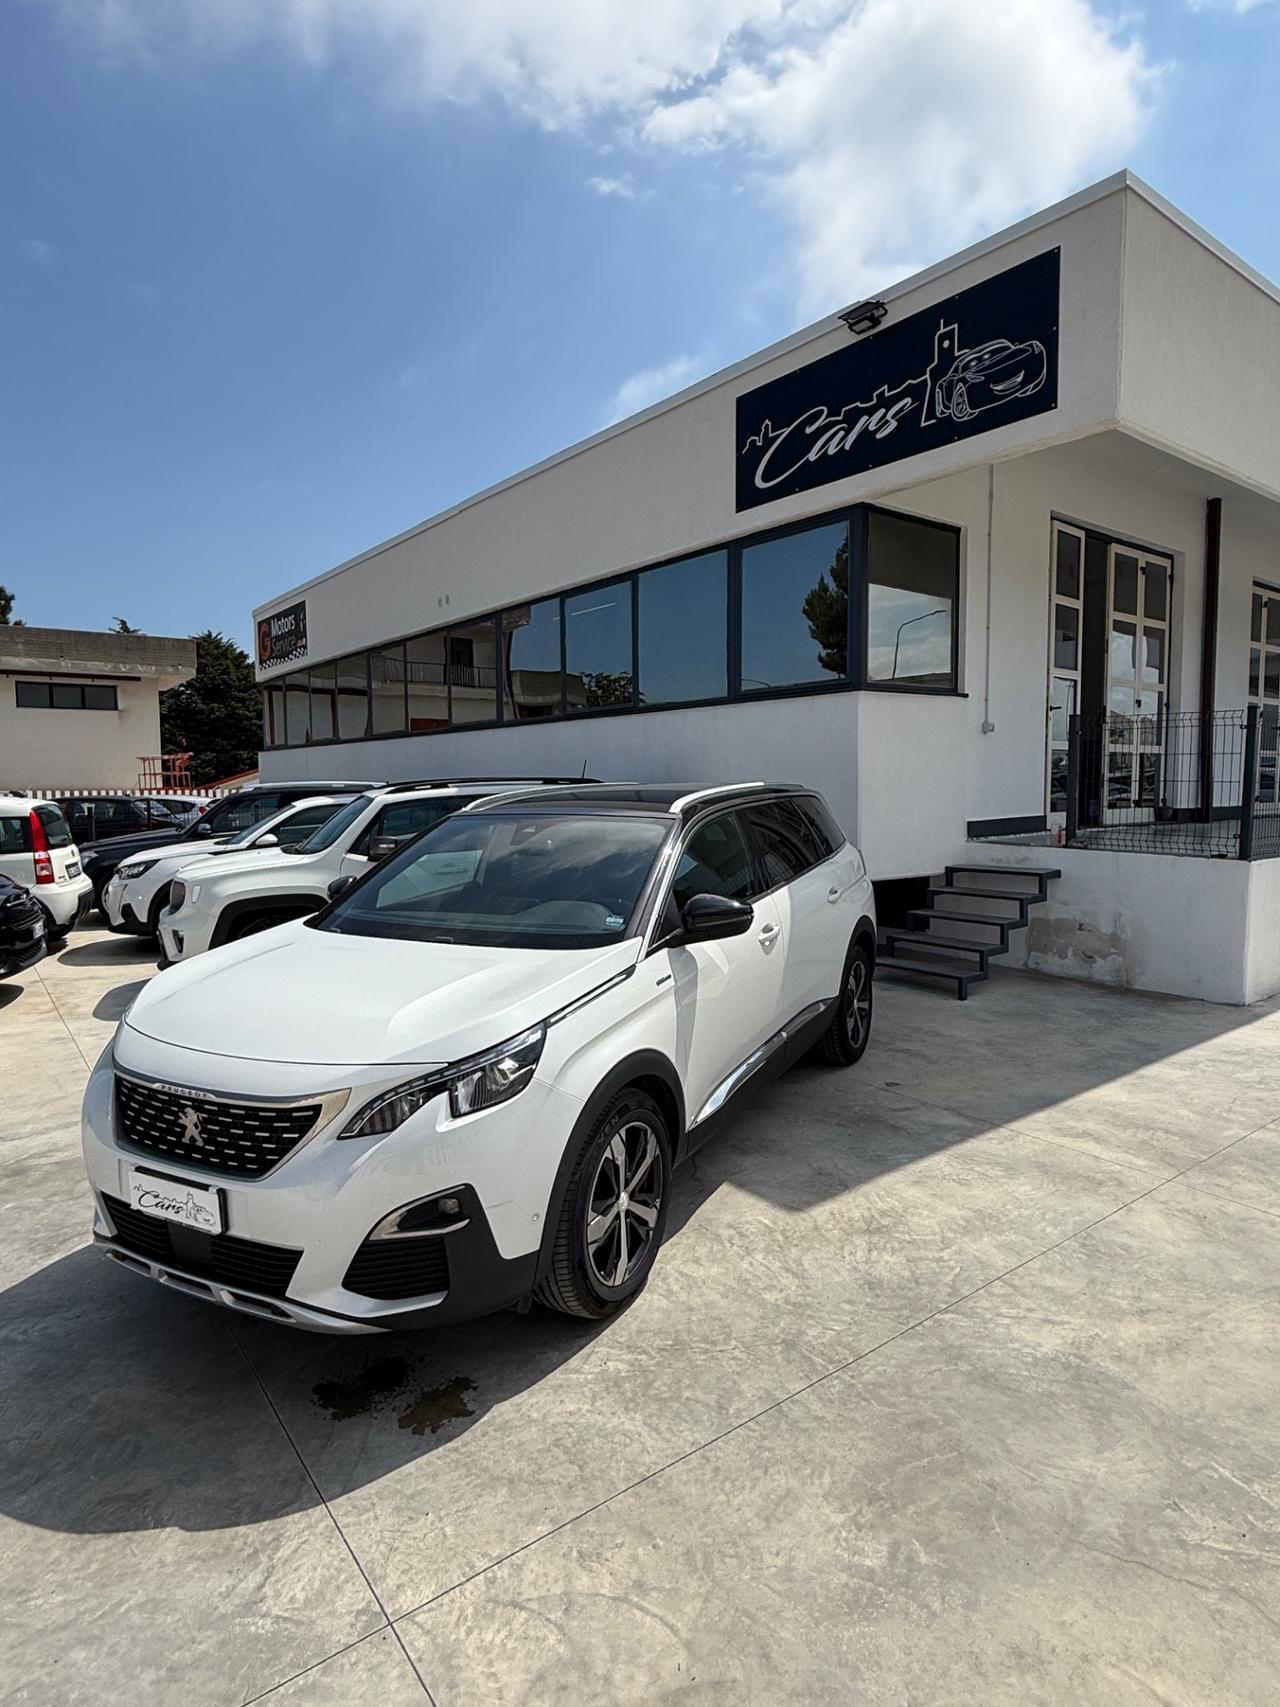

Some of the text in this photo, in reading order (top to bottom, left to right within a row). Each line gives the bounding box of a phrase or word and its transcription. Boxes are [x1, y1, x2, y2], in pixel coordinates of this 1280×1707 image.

[754, 397, 914, 488] Cars
[271, 614, 295, 638] Motors
[271, 635, 296, 657] Service
[161, 1084, 207, 1099] PEUGEOT
[138, 1190, 184, 1214] Cars
